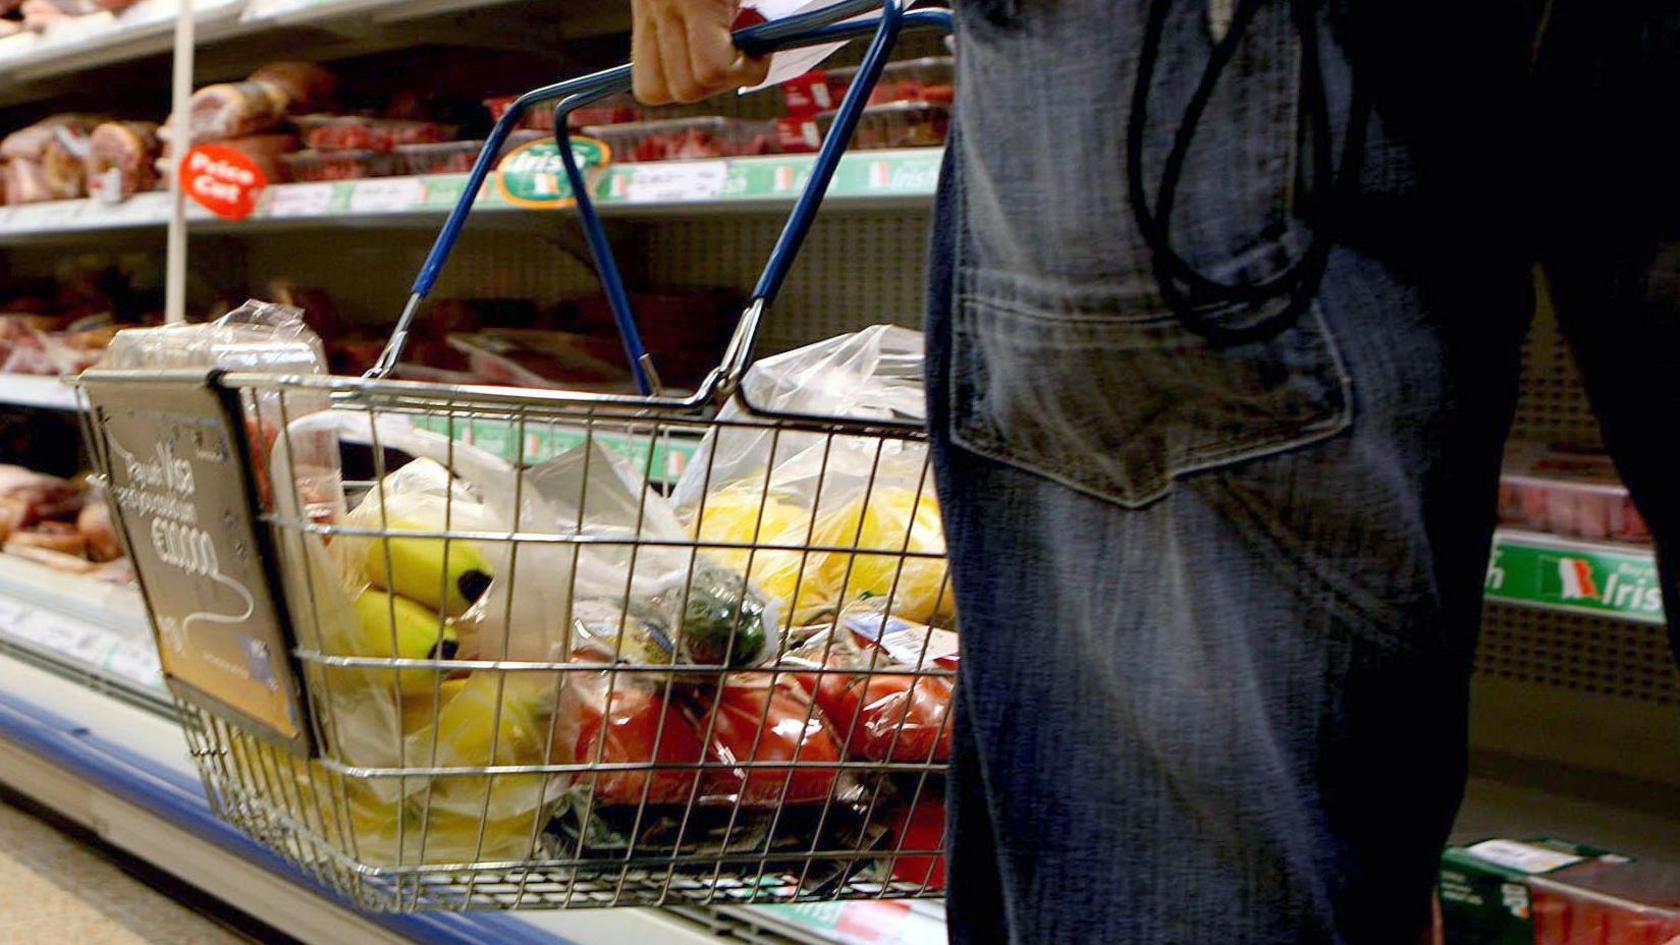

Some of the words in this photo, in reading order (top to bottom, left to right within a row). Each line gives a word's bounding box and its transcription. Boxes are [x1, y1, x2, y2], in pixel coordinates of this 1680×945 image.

[189, 151, 255, 186] Price
[193, 175, 240, 204] Cut
[1601, 573, 1662, 611] Iris
